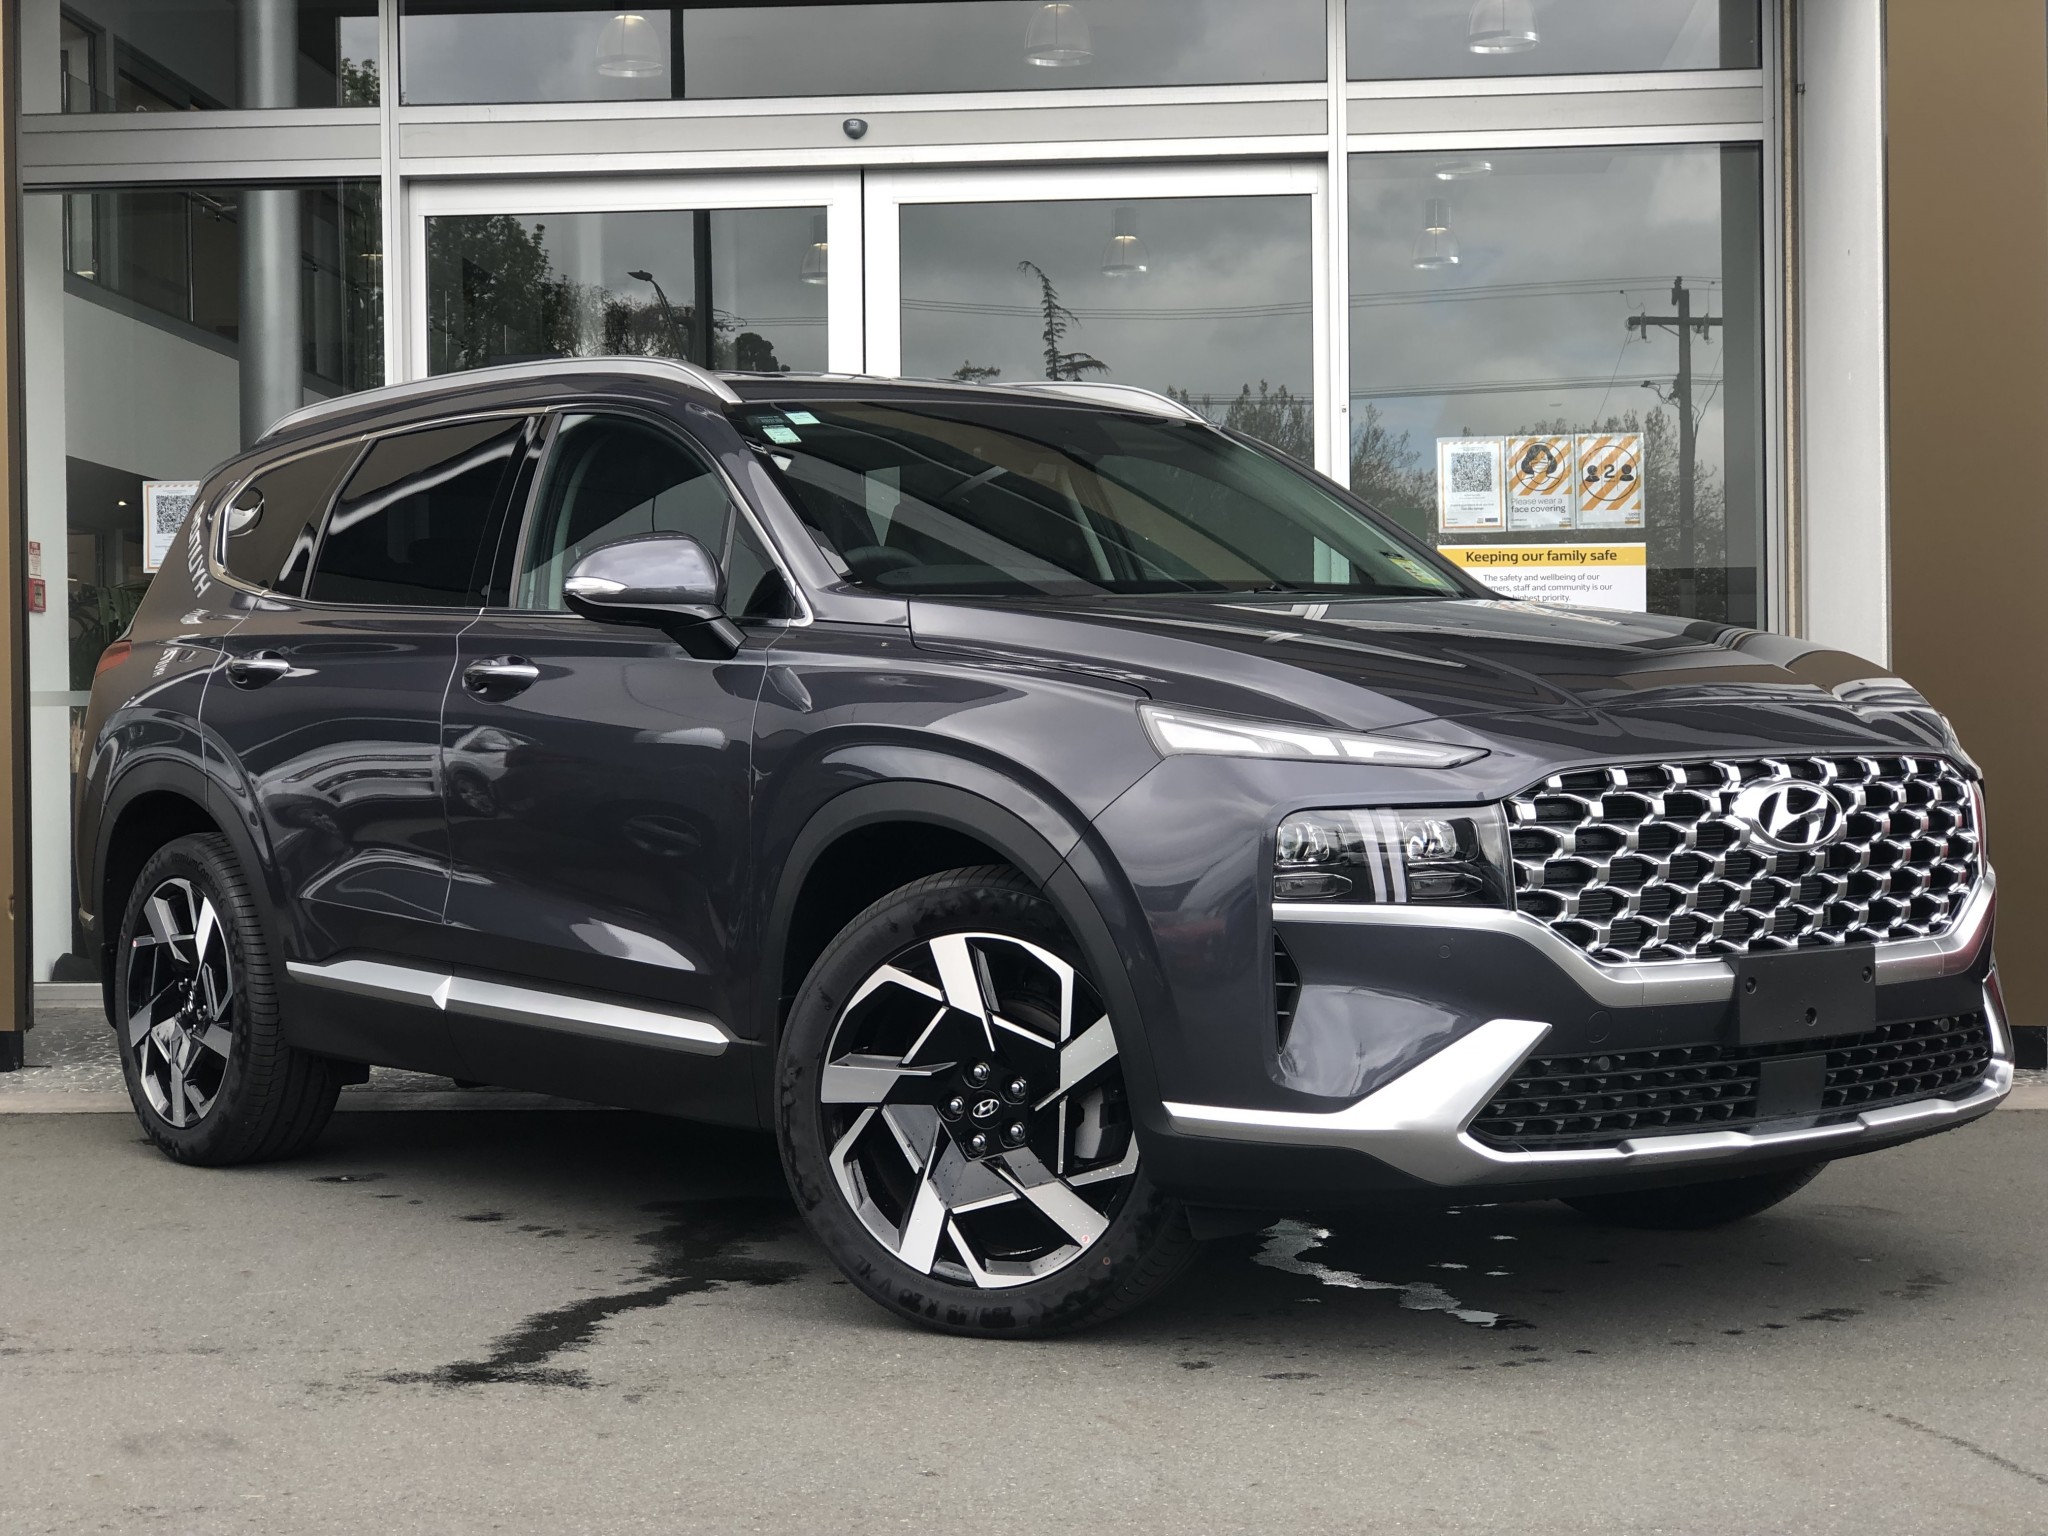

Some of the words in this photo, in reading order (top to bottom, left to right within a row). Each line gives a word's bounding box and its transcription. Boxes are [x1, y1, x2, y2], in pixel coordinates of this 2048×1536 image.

[1603, 464, 1615, 478] 2
[1530, 505, 1566, 514] covering
[1465, 551, 1518, 565] Keeping
[1521, 552, 1544, 562] our
[1547, 550, 1587, 565] family
[1590, 550, 1618, 561] safe
[1500, 573, 1522, 583] safety
[1539, 573, 1576, 582] wellbeing
[1548, 583, 1590, 592] community
[1542, 594, 1571, 602] priority.
